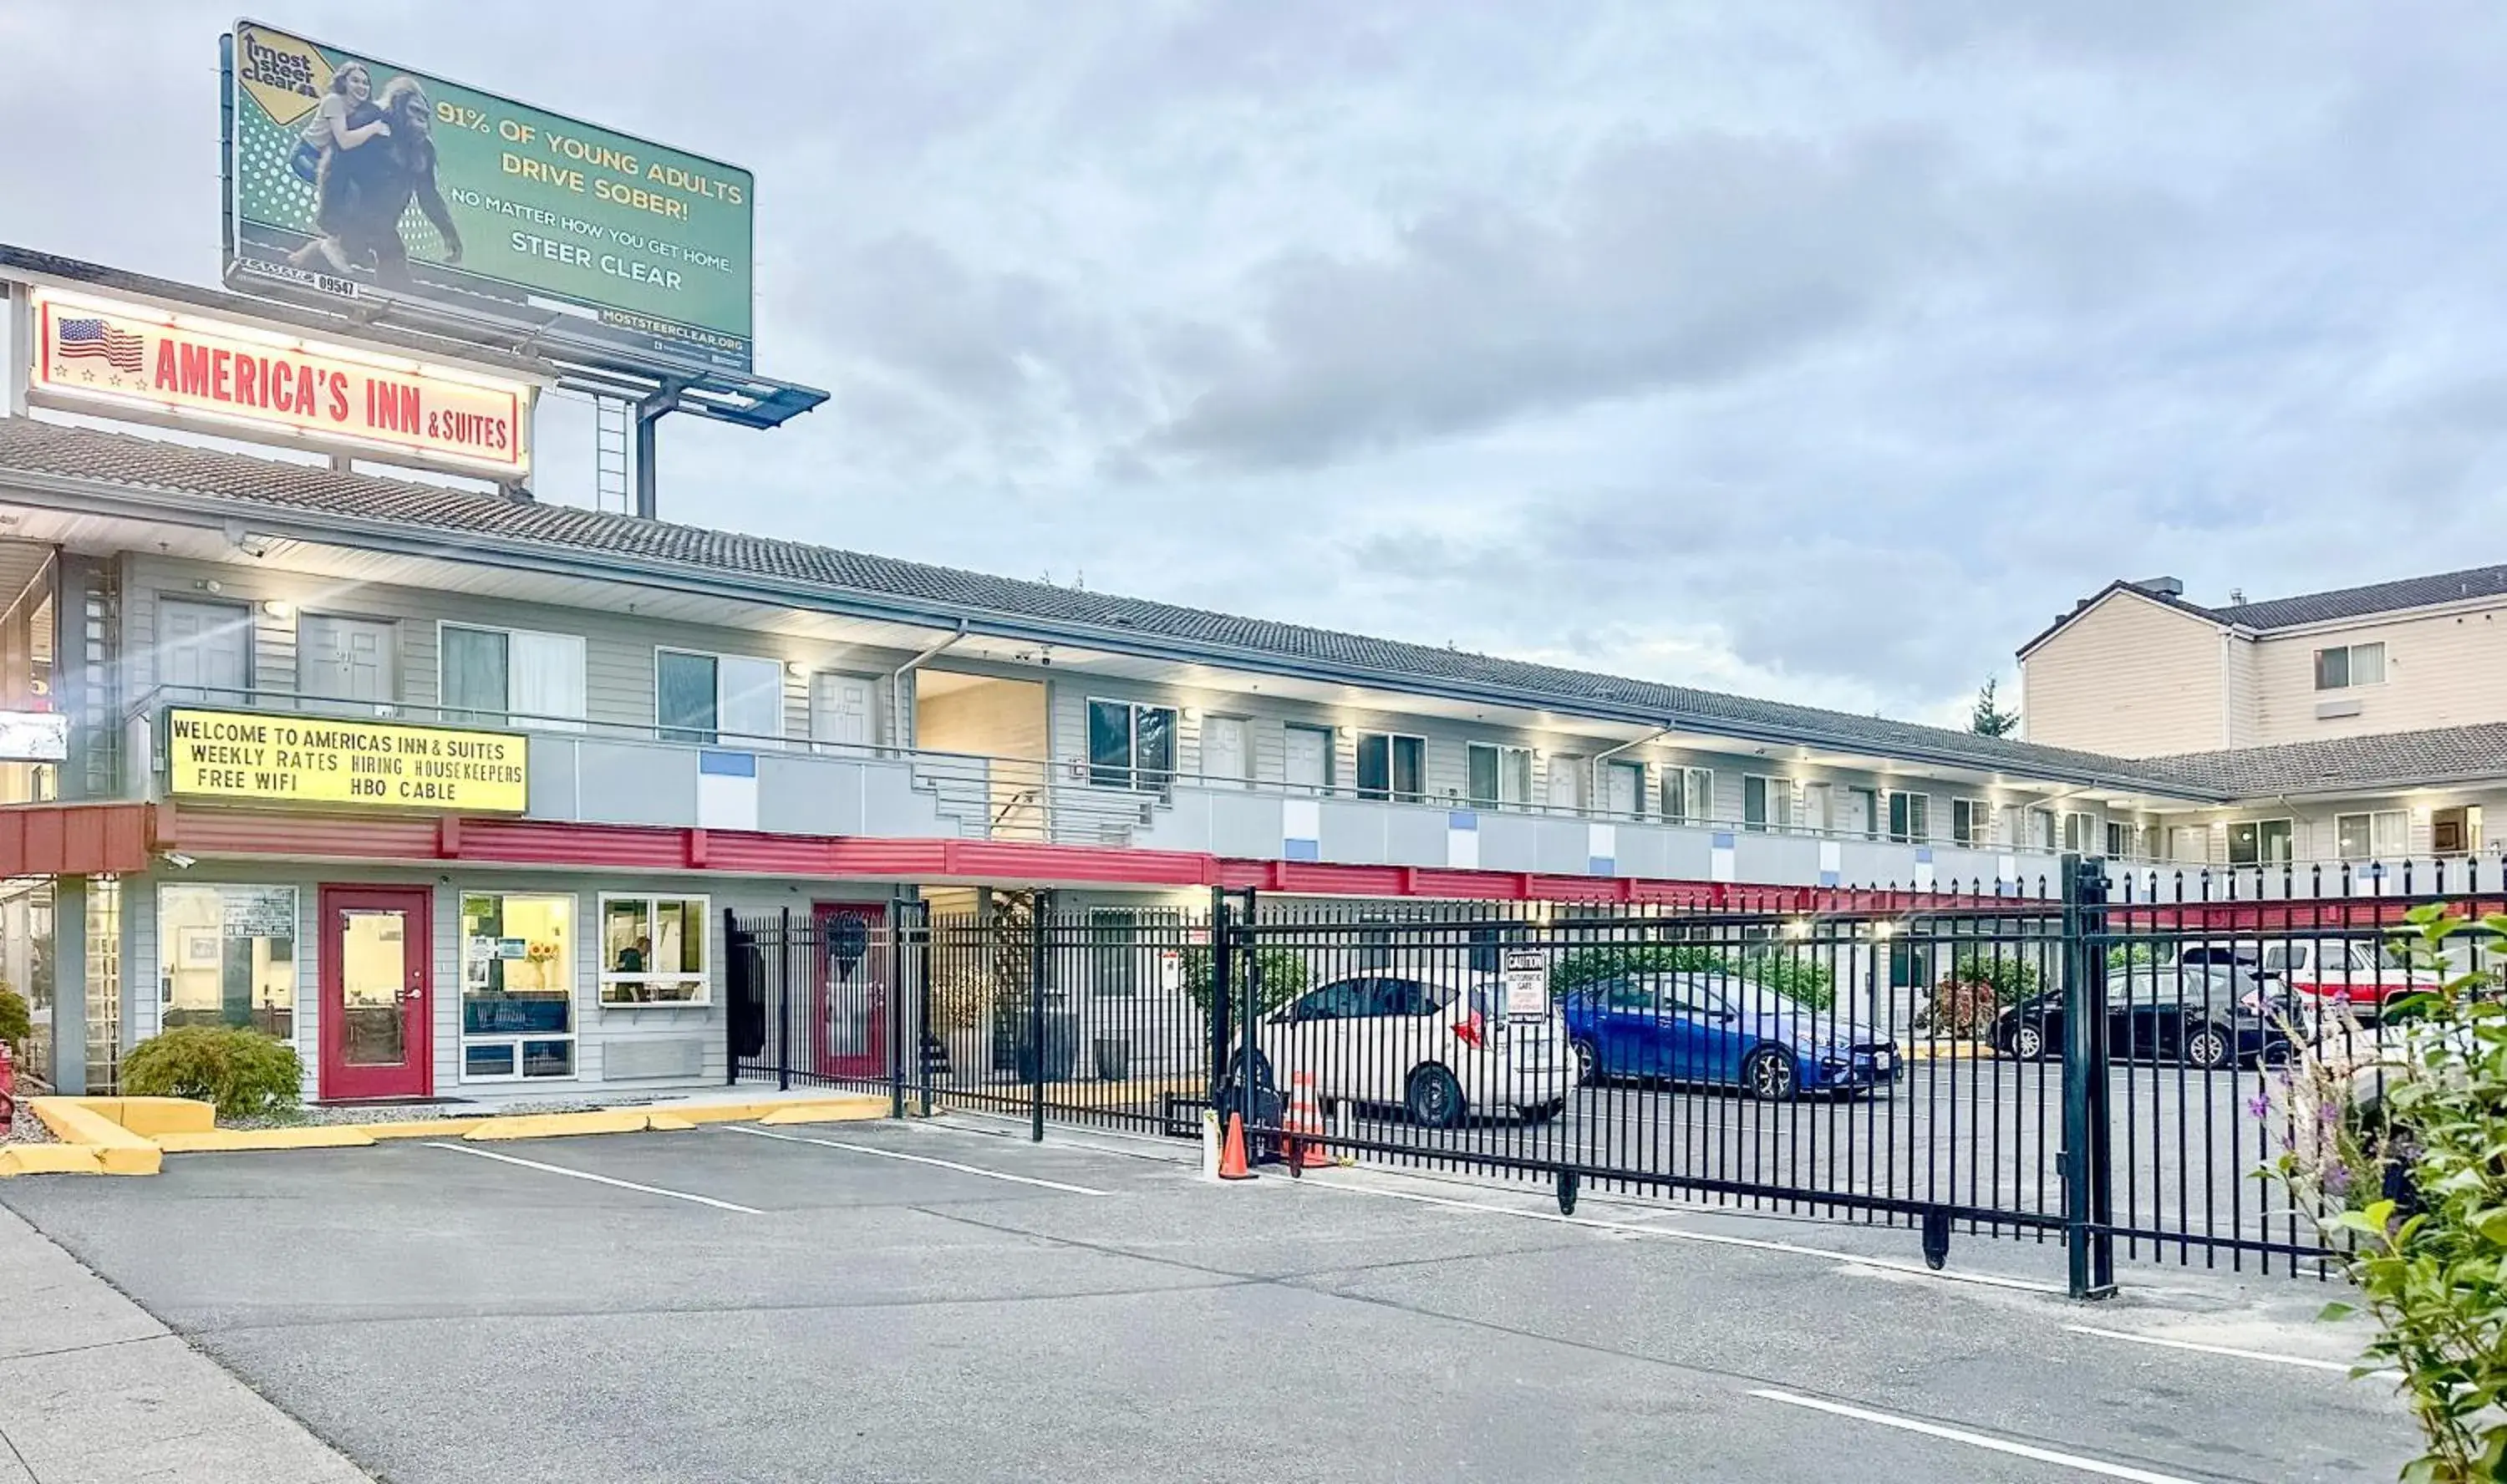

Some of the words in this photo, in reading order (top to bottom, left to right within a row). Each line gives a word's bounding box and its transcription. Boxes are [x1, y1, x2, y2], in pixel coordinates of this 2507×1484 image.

[240, 63, 297, 91] clear
[253, 44, 311, 70] most
[260, 59, 314, 83] steer
[436, 100, 491, 135] 91%
[499, 119, 536, 145] OF
[546, 132, 638, 174] YOUNG
[648, 165, 743, 205] ADULTS
[501, 152, 585, 193] DRIVE
[594, 178, 689, 221] SOBER!
[451, 188, 480, 206] NO
[486, 197, 556, 227] MATTER
[561, 217, 603, 238] HOW
[608, 228, 643, 249] YOU
[648, 240, 679, 258] GET
[511, 231, 593, 268] STEER
[600, 255, 682, 291] CLEAR
[603, 310, 743, 350] MOSTSTEERCLEAR.ORG
[155, 339, 348, 422] AMERICA'S
[366, 379, 420, 435] INN
[429, 413, 440, 439] &
[442, 409, 506, 450] SUITES
[173, 719, 267, 744] WELCOME
[277, 728, 297, 746] TO
[303, 730, 392, 752] AMERICAS
[399, 736, 427, 755] INN
[432, 739, 440, 755] &
[447, 740, 504, 760] SUITES
[191, 745, 264, 767] WEEKLY
[277, 750, 338, 771] RATES
[352, 756, 402, 775] HIRING
[415, 760, 522, 784] HOUSEKEEPERS
[198, 768, 245, 789] FREE
[255, 772, 297, 791] WIFI
[351, 778, 387, 796] HBO
[400, 781, 455, 800] CABLE
[1509, 955, 1542, 968] CAUTION
